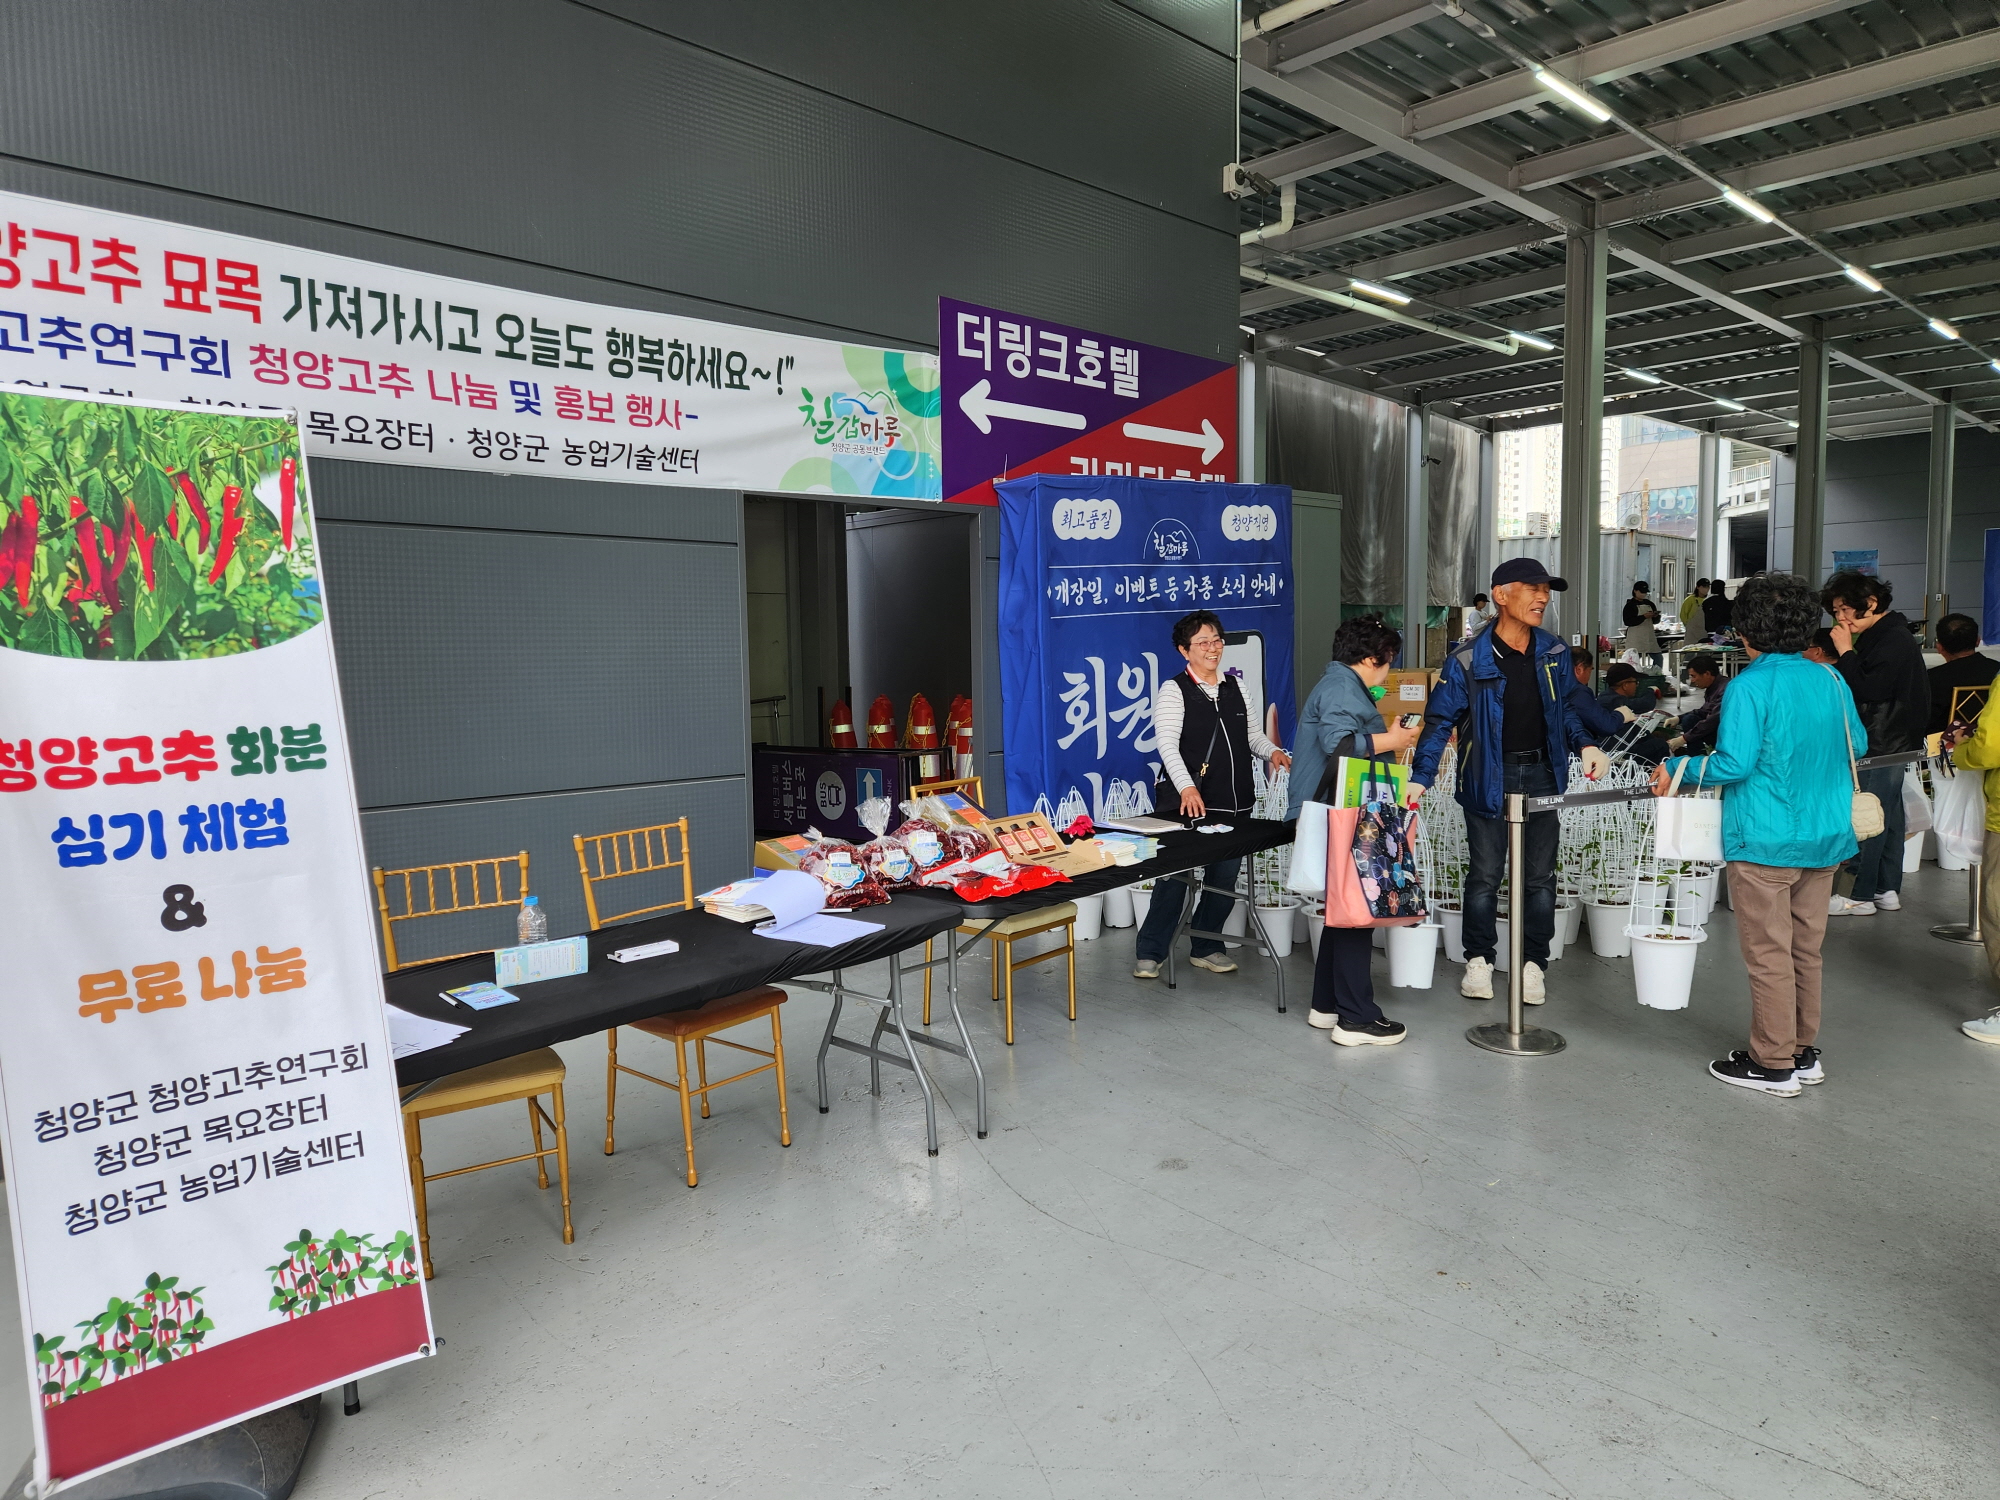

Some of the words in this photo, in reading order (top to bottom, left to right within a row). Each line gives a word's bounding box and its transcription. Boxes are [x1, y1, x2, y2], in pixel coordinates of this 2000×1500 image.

[164, 250, 262, 324] 묘목
[280, 274, 482, 355] 가져가시고
[495, 313, 594, 371] 오늘도
[605, 326, 794, 395] 행복하세요~!"
[957, 312, 1140, 398] 더링크호텔
[0, 310, 231, 378] 고추연구회
[249, 343, 414, 399] 청양고추
[429, 369, 498, 410] 나눔
[509, 379, 541, 416] 및
[554, 385, 615, 425] 홍보
[306, 410, 434, 453] 목요장터
[466, 427, 549, 463] 청양군
[562, 437, 699, 475] 농업기술센터
[798, 387, 901, 447] 칠갑마루
[1061, 509, 1112, 530] 최고품질
[1231, 514, 1269, 532] 청양직영
[1055, 577, 1108, 606] 개장일,
[1115, 576, 1160, 603] 이벤트
[1164, 576, 1180, 602] 등
[1183, 573, 1214, 601] 각종
[1218, 573, 1246, 598] 소식
[1250, 572, 1277, 597] 안내
[1057, 652, 1159, 759] 회원
[226, 723, 327, 776] 화분
[782, 760, 794, 825] 셔틀버스
[1537, 798, 1549, 806] THE
[1550, 796, 1565, 805] LINK
[1635, 787, 1649, 795] LINK
[51, 810, 167, 868] 심기
[178, 798, 290, 854] 체험
[160, 884, 207, 932] &
[78, 961, 186, 1024] 무료
[198, 945, 307, 1001] 나눔
[34, 1091, 139, 1143] 청양군
[148, 1042, 369, 1114] 청양고추연구회
[93, 1126, 192, 1177] 청양군
[203, 1094, 329, 1145] 목요장터
[65, 1180, 167, 1236] 청양군
[179, 1131, 365, 1203] 농업기술센터
